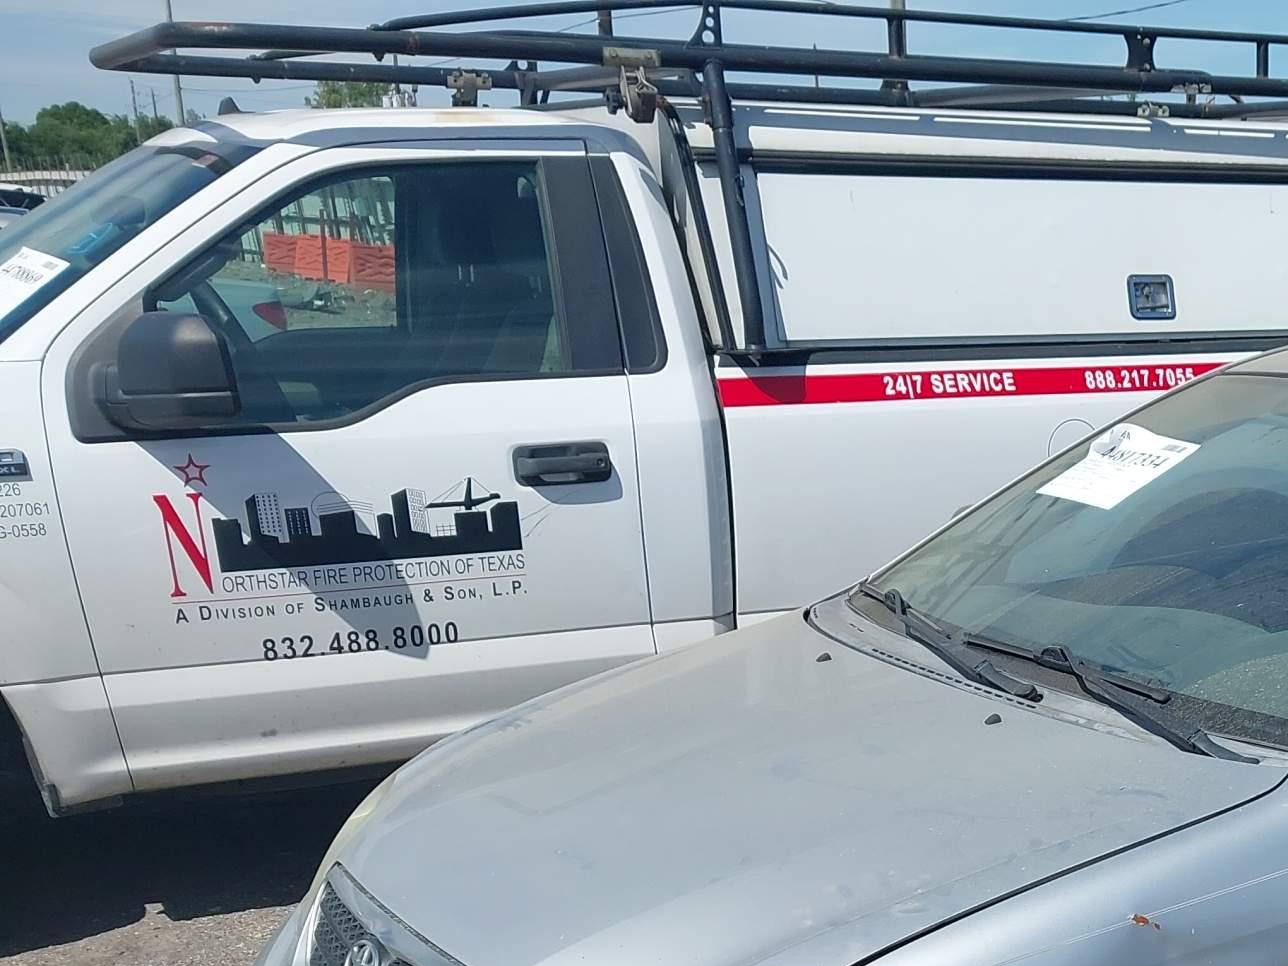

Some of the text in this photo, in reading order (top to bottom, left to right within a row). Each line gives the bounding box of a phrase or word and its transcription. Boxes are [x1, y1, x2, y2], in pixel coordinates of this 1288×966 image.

[931, 372, 1017, 394] SERVICE
[1085, 367, 1195, 390] 888.217.7055
[0, 502, 50, 518] 207061
[313, 567, 349, 587] FIRE
[353, 559, 451, 584] PROTECTION
[455, 557, 474, 575] OF
[478, 553, 526, 573] TEXAS
[175, 608, 190, 624] A
[423, 588, 435, 603] &
[492, 580, 528, 597] L.P.
[262, 621, 459, 661] 832.488.8000
